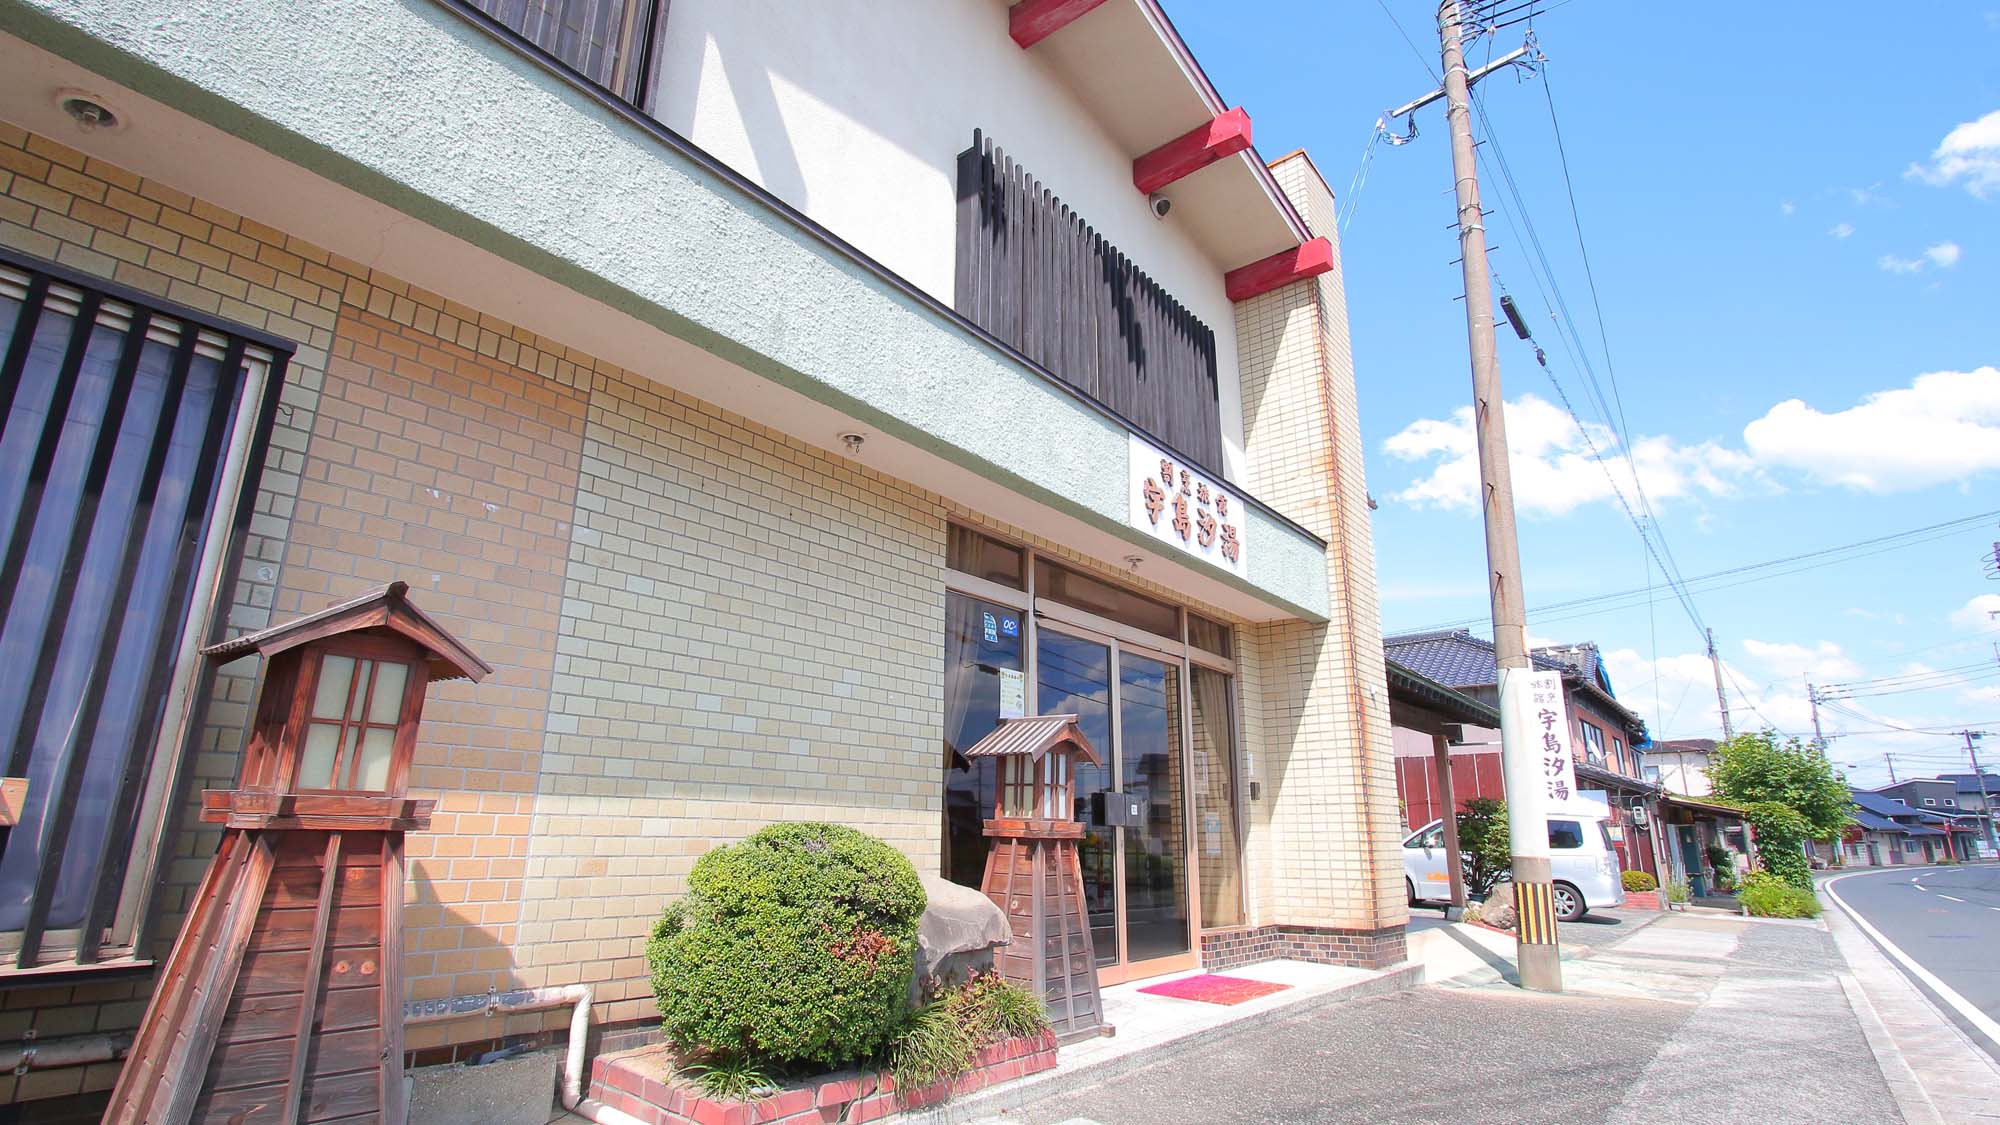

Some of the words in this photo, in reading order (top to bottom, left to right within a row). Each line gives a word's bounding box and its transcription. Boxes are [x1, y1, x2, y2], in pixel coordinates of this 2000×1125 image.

[1143, 477, 1240, 563] 宇島汐湯
[1538, 708, 1569, 801] 宇島汐湯
